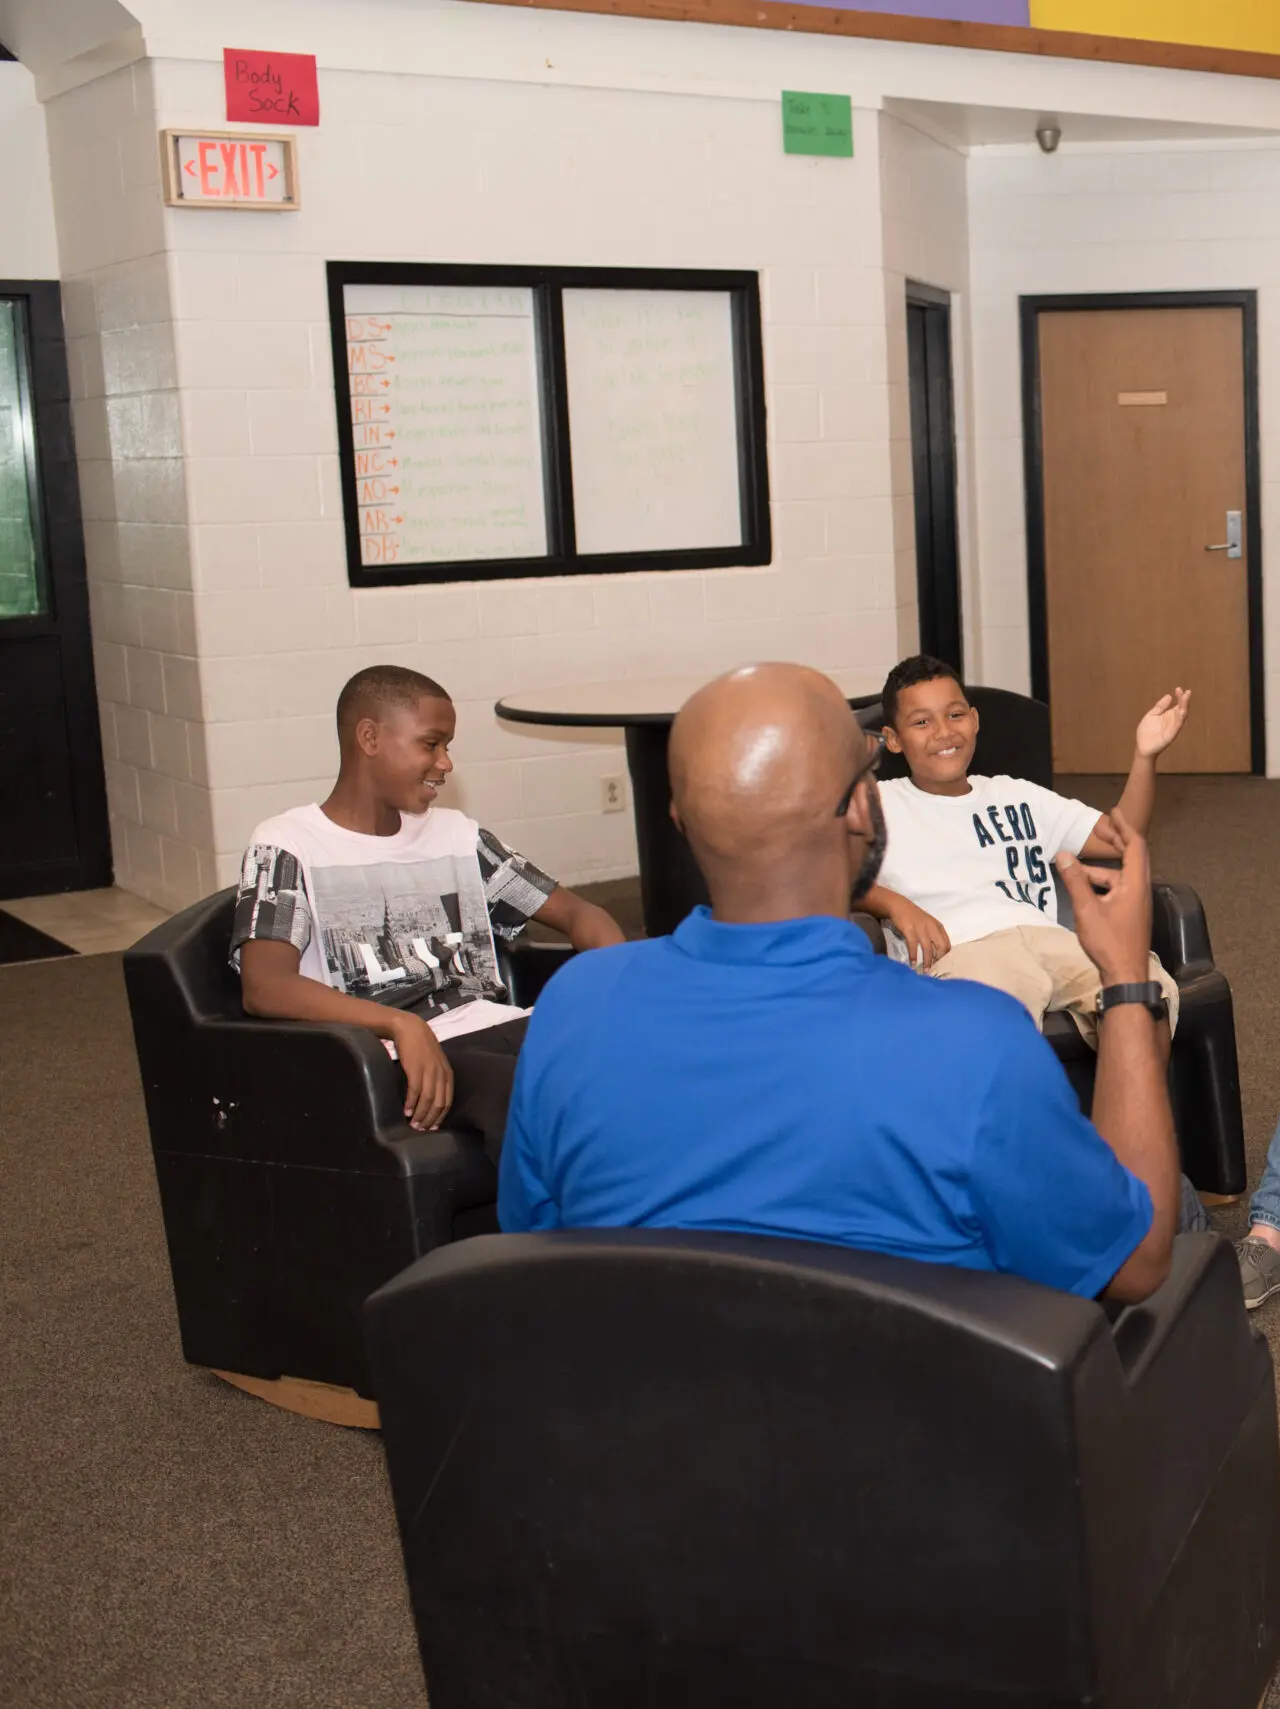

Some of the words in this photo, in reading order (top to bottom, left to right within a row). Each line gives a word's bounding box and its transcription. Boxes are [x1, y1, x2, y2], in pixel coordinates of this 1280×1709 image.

[235, 59, 282, 94] Body
[248, 89, 300, 117] Sock
[198, 141, 267, 198] EXIT
